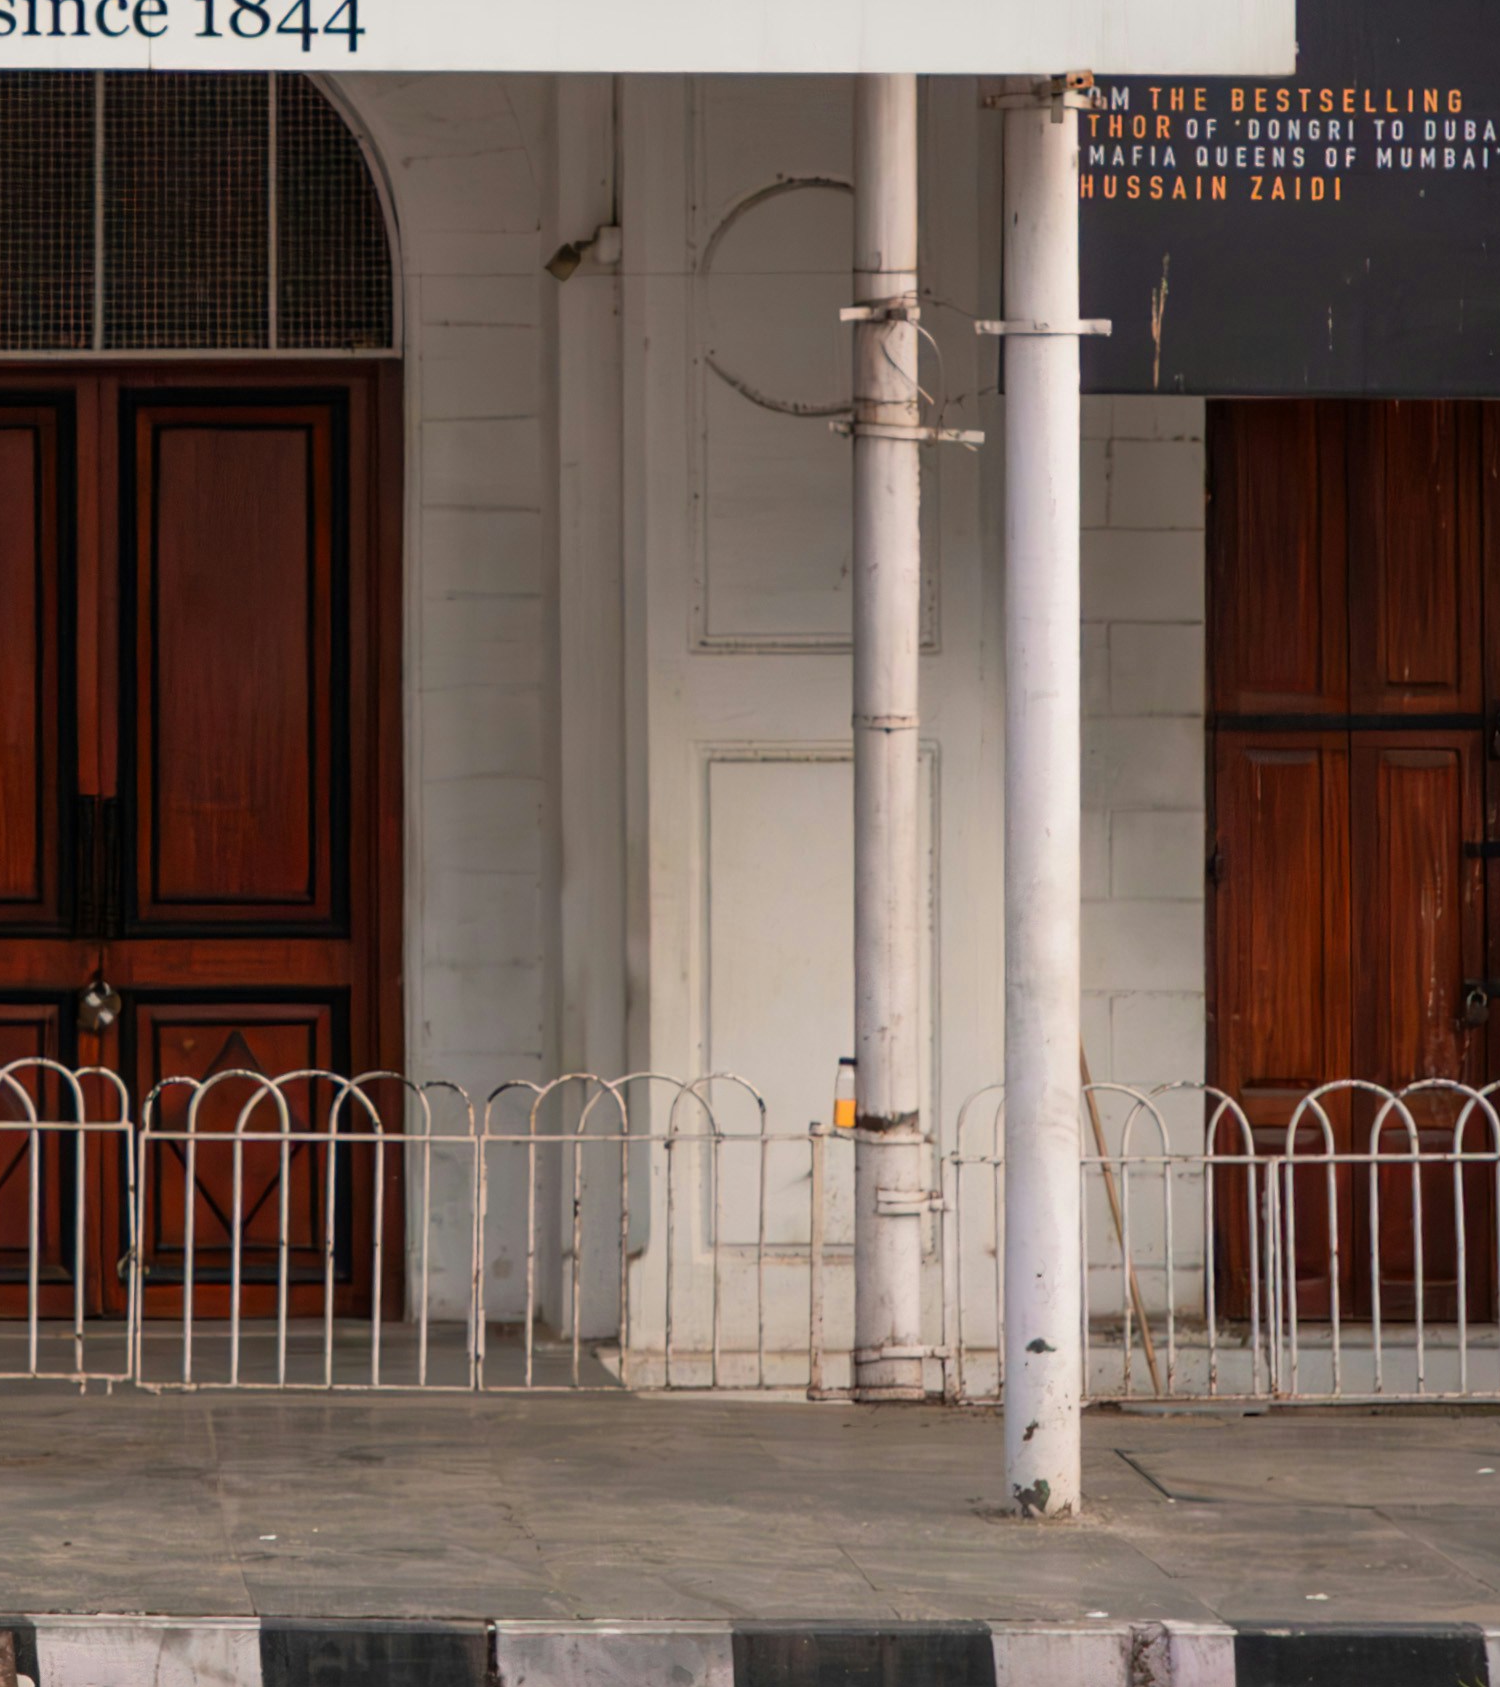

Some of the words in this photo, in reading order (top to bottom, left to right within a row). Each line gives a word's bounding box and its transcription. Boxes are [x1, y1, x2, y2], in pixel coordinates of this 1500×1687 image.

[1149, 87, 1208, 111] THE
[1231, 88, 1463, 113] BESTSELLING
[1186, 118, 1217, 140] OF
[1374, 119, 1404, 141] TO
[1196, 146, 1306, 169] QUEENS
[1325, 147, 1357, 169] OF
[1080, 174, 1227, 201] HUSSAIN
[1250, 175, 1341, 202] ZAIDI
